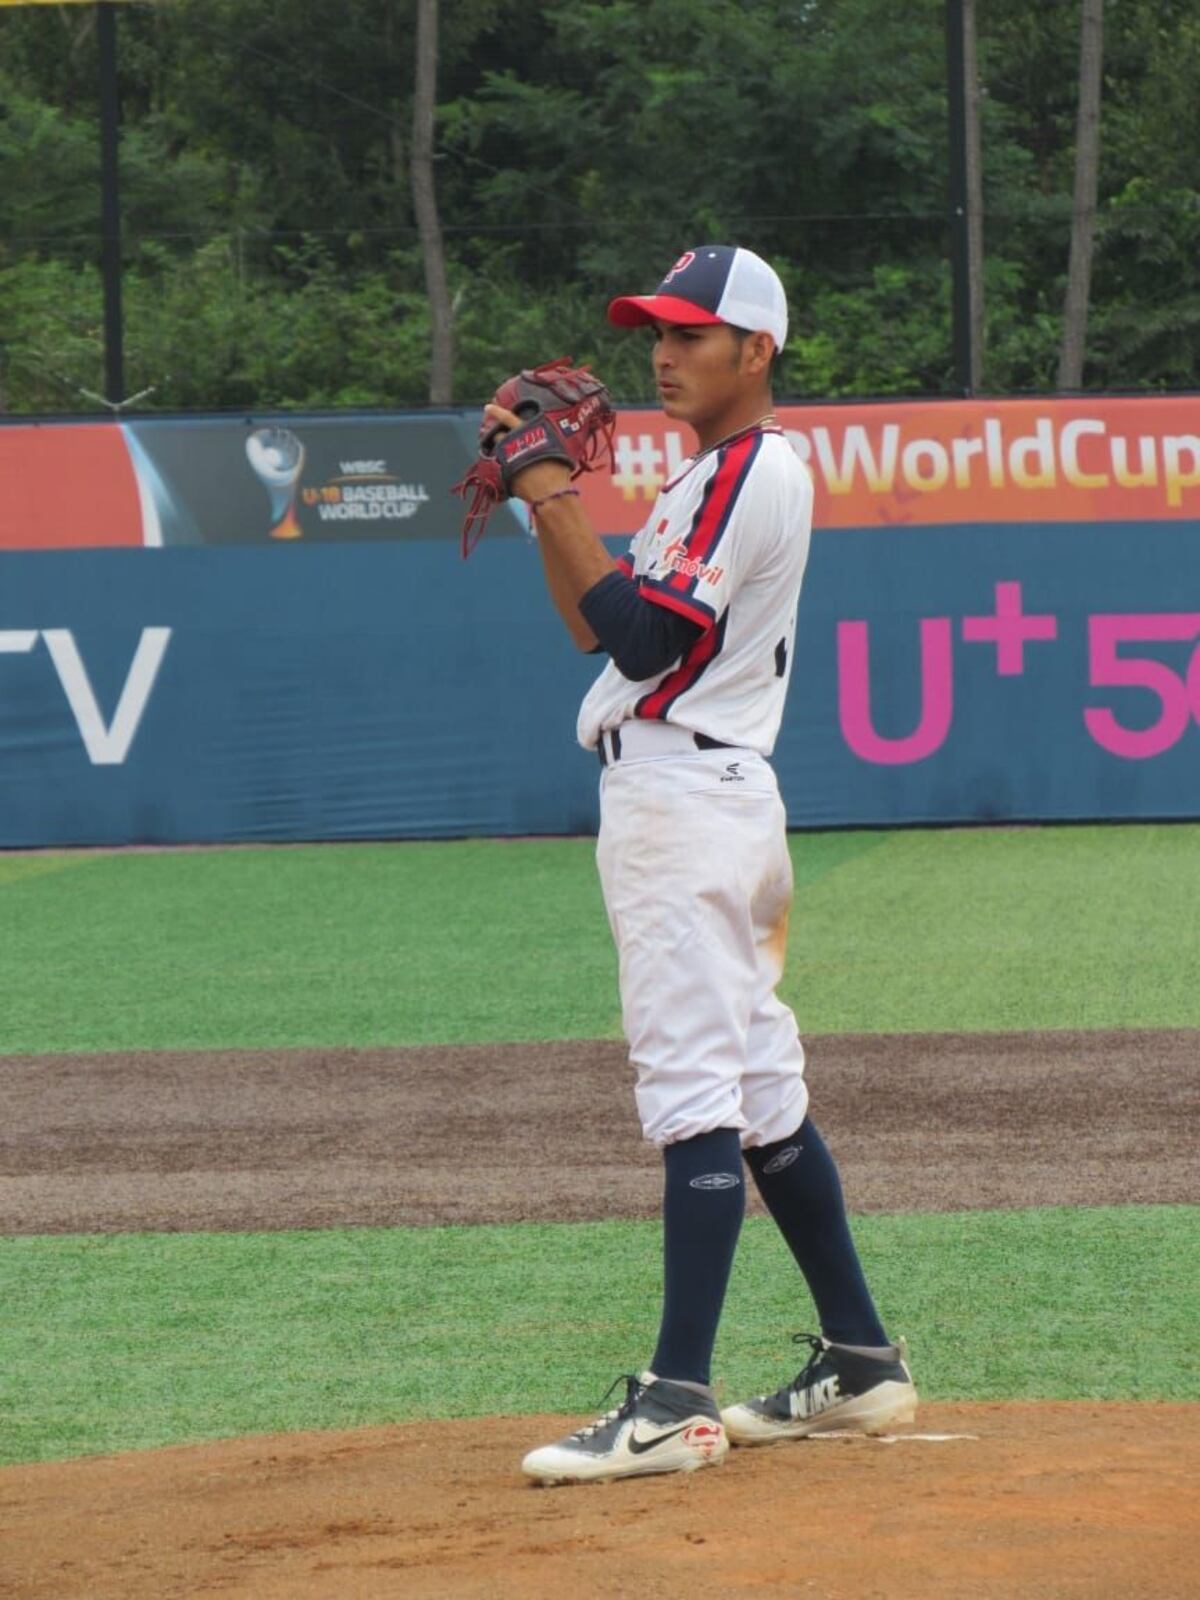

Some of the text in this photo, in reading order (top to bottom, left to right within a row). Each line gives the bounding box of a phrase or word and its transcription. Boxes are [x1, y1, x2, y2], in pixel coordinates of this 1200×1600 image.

[342, 484, 429, 503] BASEBALL
[318, 501, 418, 521] WORLD CUP
[1083, 612, 1200, 760] 5
[789, 1374, 842, 1420] NIKE
